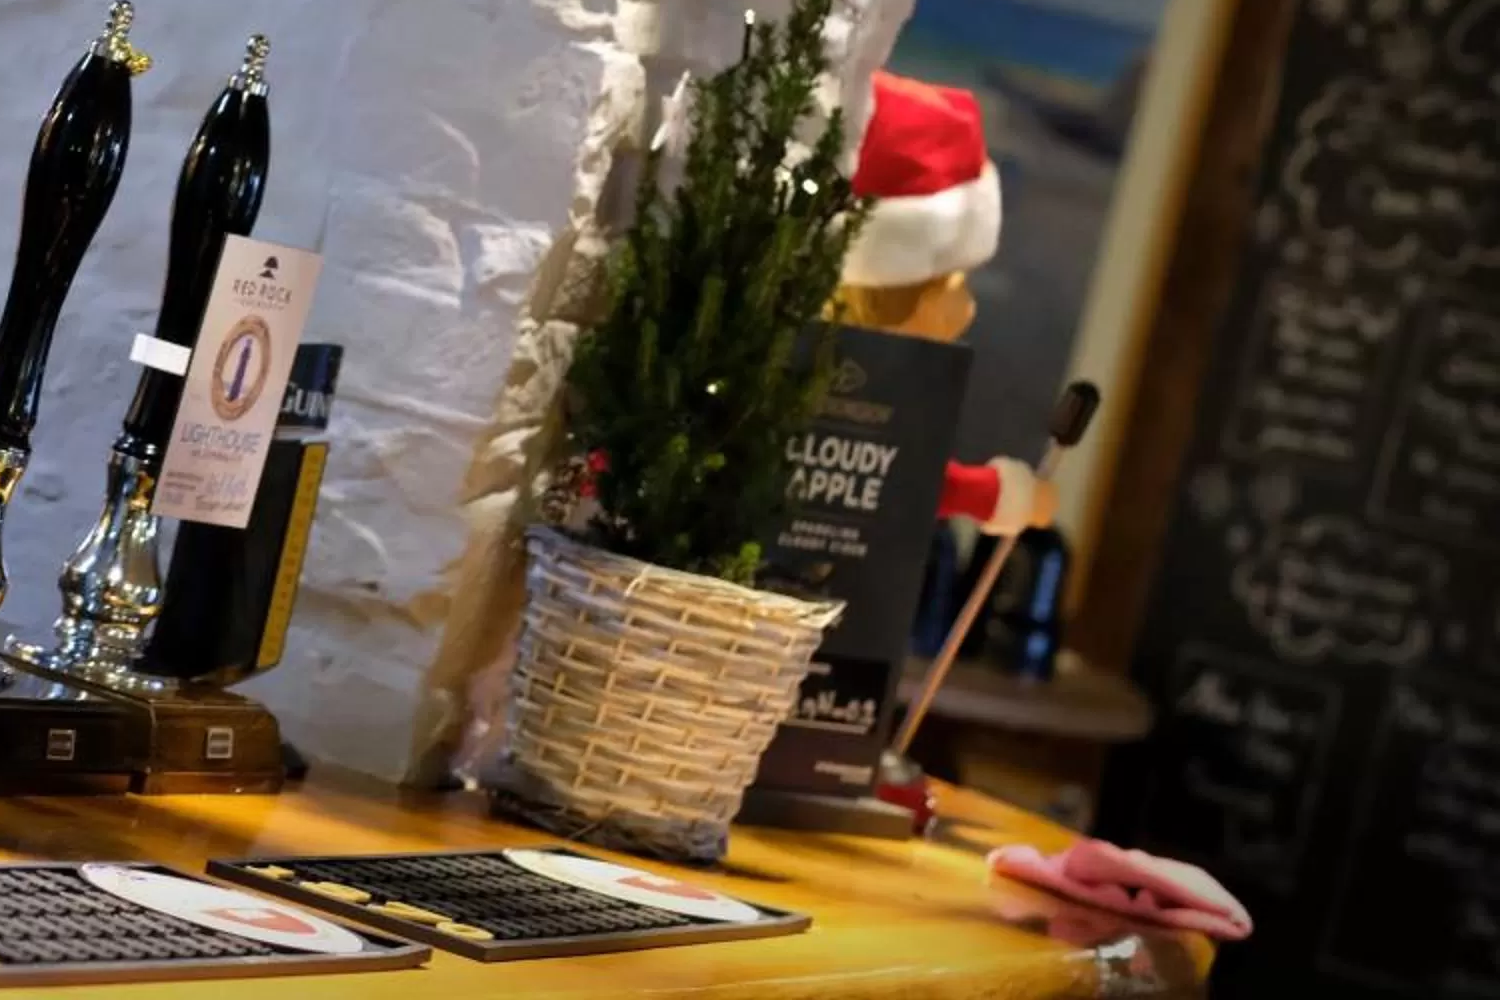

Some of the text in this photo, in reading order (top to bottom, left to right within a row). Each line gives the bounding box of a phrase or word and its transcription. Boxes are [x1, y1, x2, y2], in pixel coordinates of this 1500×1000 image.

[233, 279, 257, 296] RED
[259, 283, 292, 305] ROCK
[180, 423, 262, 454] LIGHTHOUSE
[785, 432, 900, 477] CLOUDY
[785, 466, 883, 510] APPLE
